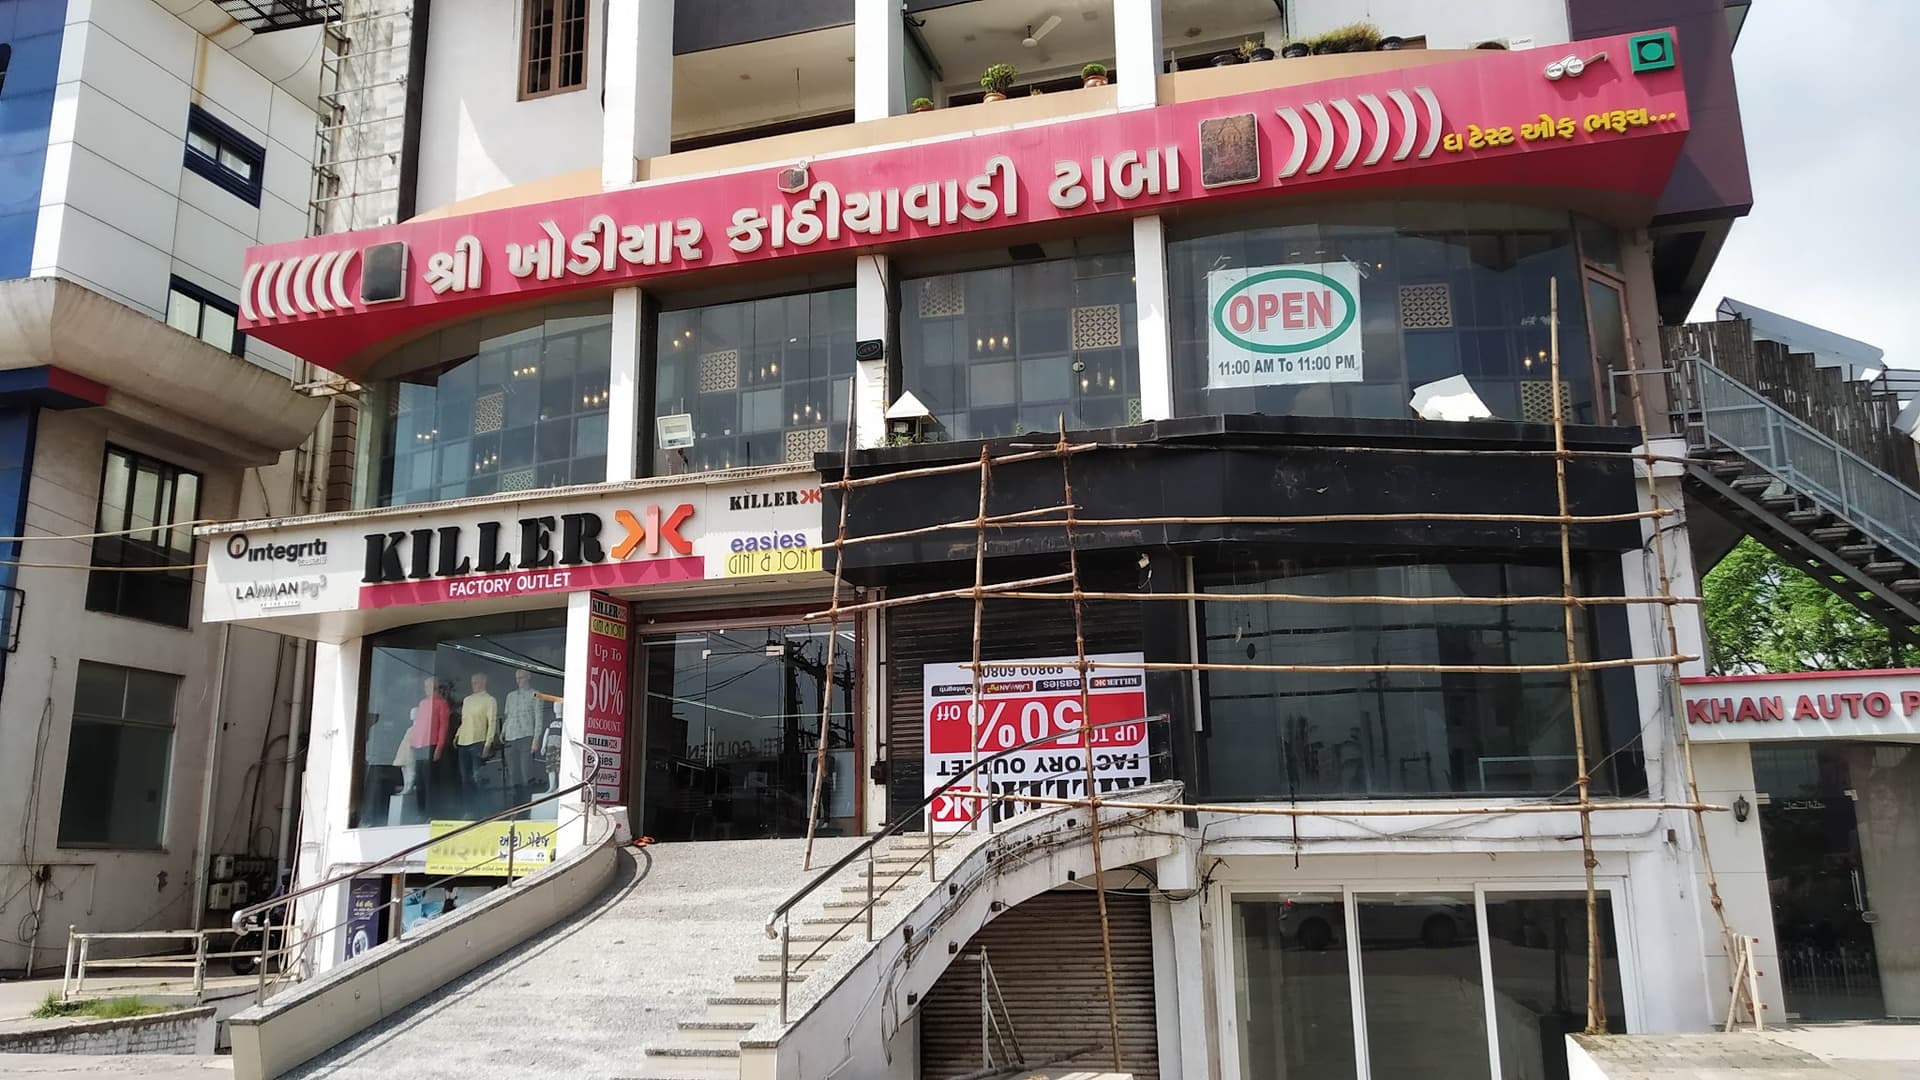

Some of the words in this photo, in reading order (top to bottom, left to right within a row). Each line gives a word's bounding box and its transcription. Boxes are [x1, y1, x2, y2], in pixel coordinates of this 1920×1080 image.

[422, 234, 483, 295] શ્રી
[505, 213, 704, 281] ખોડીયાર
[726, 155, 1020, 254] કાઠીયાવાડી
[1048, 143, 1182, 210] ઢાબા
[1228, 290, 1334, 334] OPEN
[1218, 359, 1250, 376] 11:00
[1254, 358, 1275, 373] AM
[1278, 358, 1293, 373] To
[1297, 355, 1331, 372] 11:00
[1335, 354, 1356, 370] PM
[729, 490, 799, 511] KILLER
[361, 512, 606, 584] KILLER
[730, 530, 807, 553] easies
[728, 553, 754, 575] GINI
[760, 552, 771, 572] &
[777, 549, 816, 572] JONY
[449, 577, 513, 598] FACTORY
[516, 571, 572, 591] OUTLET
[594, 643, 609, 662] Up
[610, 647, 622, 662] To
[587, 667, 624, 715] 50%
[1042, 679, 1080, 690] easies
[1686, 695, 1784, 724] KHAN
[1792, 691, 1892, 721] AUTO
[587, 716, 621, 733] DISCOUNT
[967, 700, 1084, 749] 50%
[1114, 725, 1138, 742] UP
